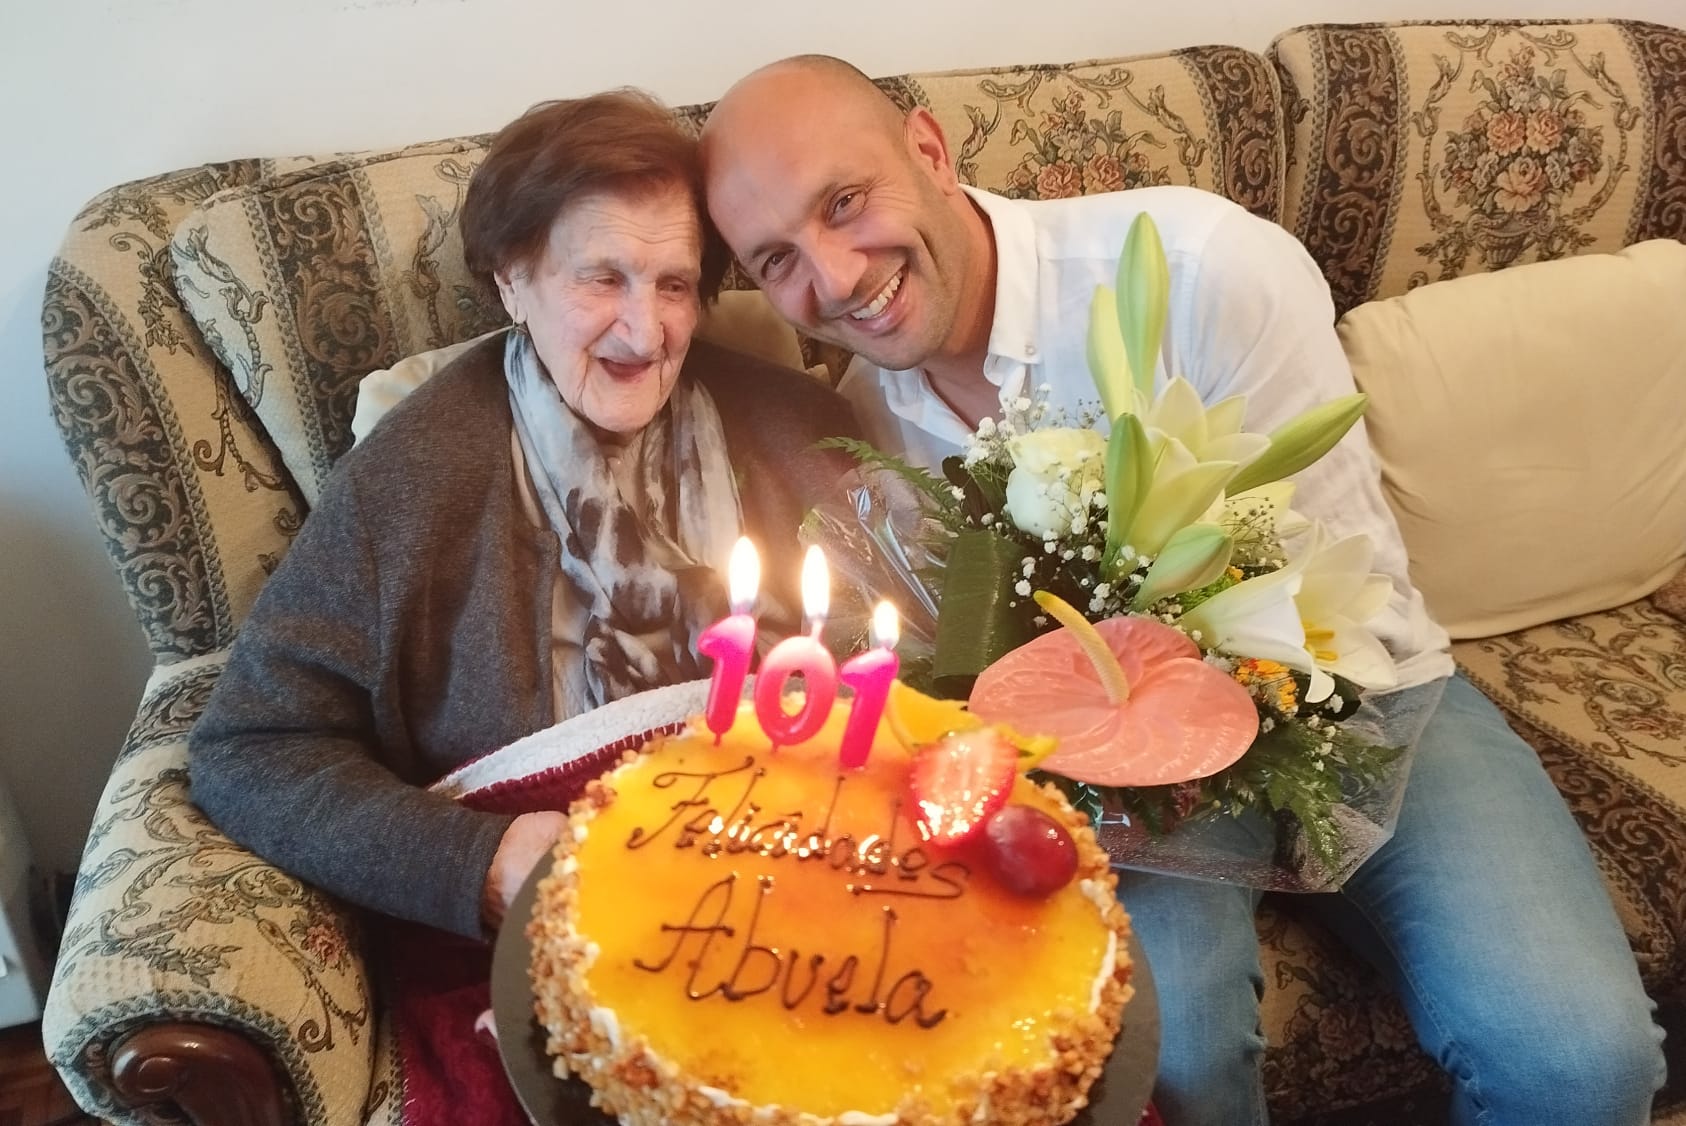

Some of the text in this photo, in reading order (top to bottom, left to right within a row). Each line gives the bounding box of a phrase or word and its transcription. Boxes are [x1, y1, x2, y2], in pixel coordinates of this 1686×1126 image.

[697, 614, 899, 769] 101
[626, 756, 970, 898] Felicidades
[634, 873, 947, 1029] Abuela
